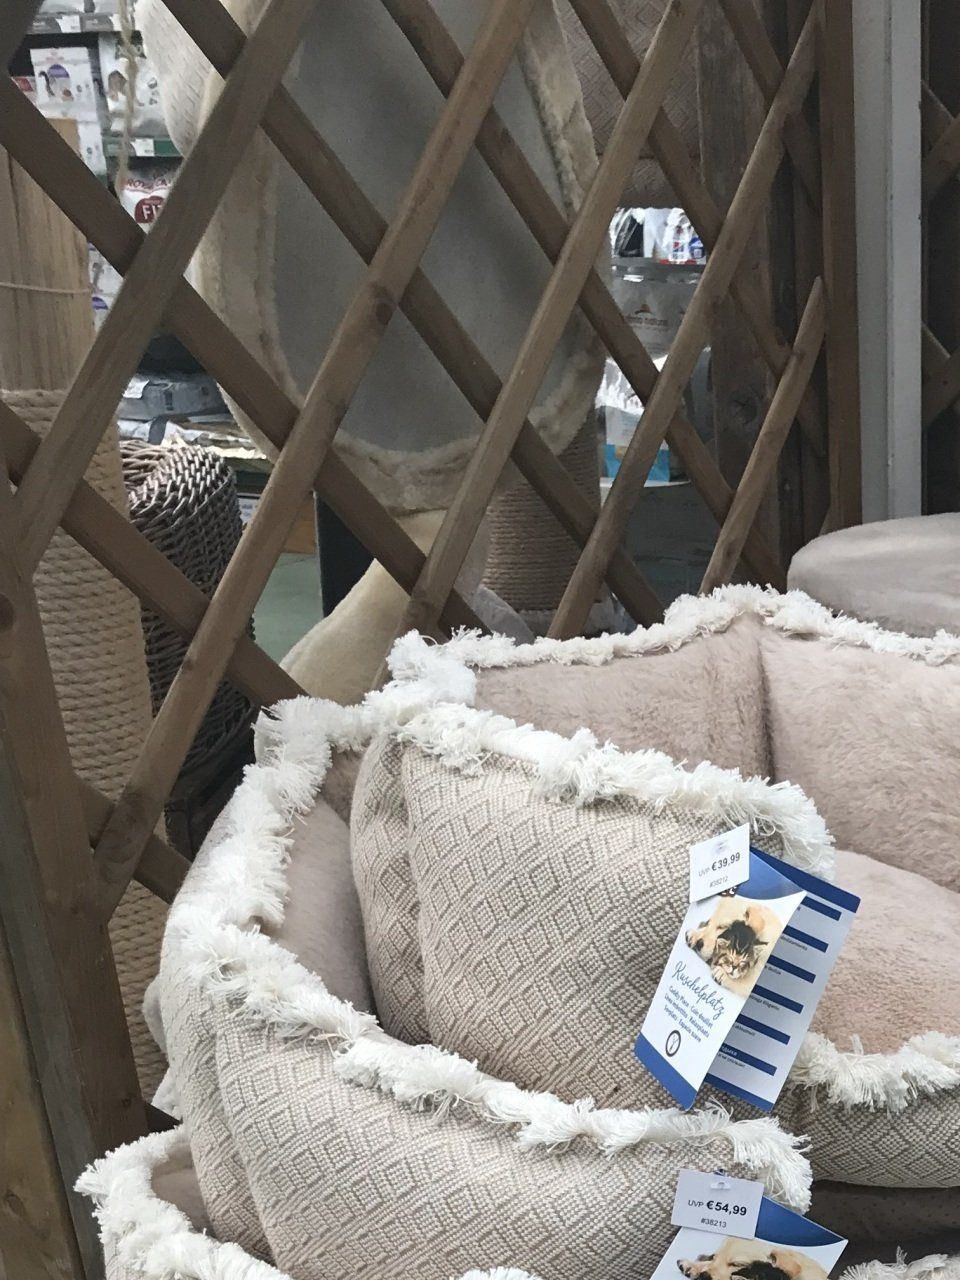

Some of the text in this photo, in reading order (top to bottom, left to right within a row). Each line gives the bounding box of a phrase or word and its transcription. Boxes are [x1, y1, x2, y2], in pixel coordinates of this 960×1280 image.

[672, 961, 724, 1020] Kuschelplatz
[688, 1199, 747, 1216] UVP €54,99
[700, 1218, 727, 1228] #38213
